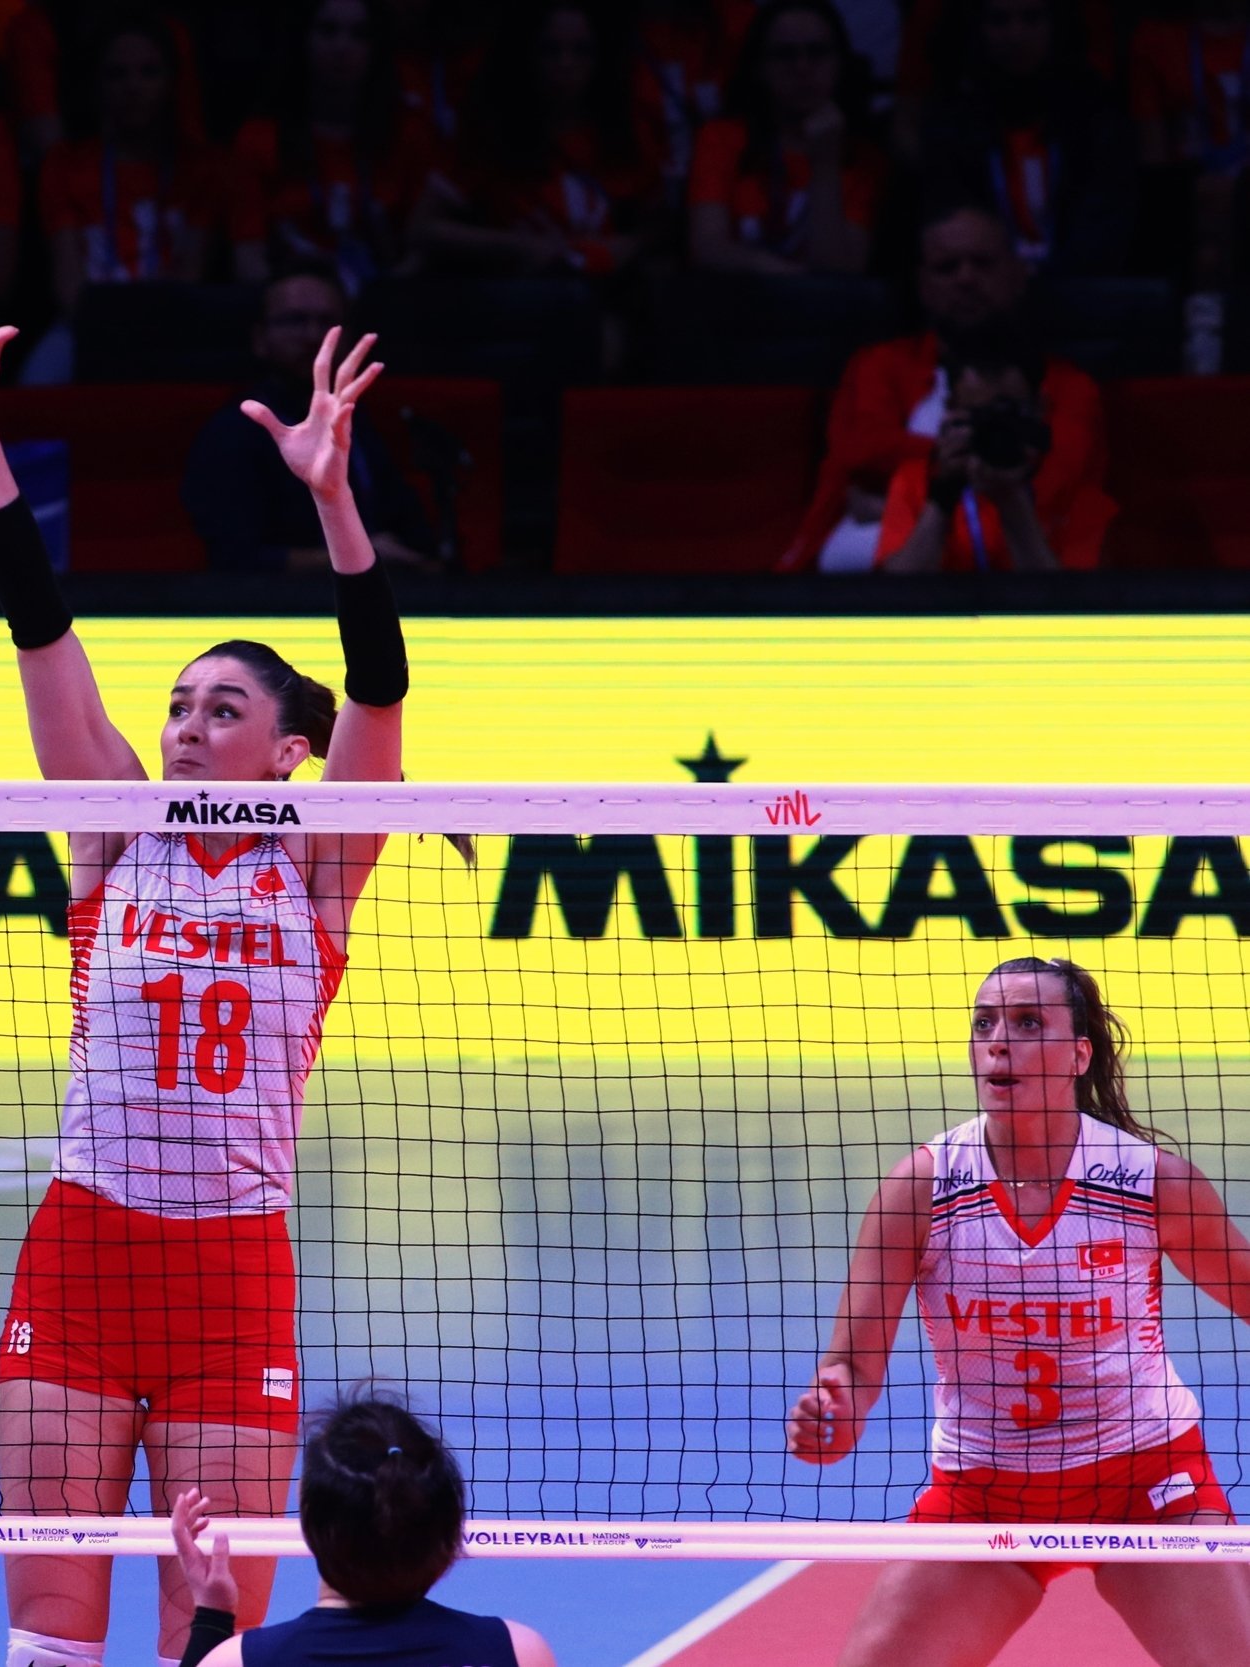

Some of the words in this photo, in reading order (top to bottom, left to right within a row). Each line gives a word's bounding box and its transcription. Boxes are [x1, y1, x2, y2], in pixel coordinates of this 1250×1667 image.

[165, 790, 301, 825] MIKASA
[765, 790, 822, 826] VNL
[121, 903, 297, 967] VESTEL
[141, 972, 251, 1095] 18
[1087, 1163, 1144, 1189] Orkid
[945, 1293, 1124, 1339] VESTEL
[7, 1319, 33, 1355] 18
[1010, 1350, 1062, 1429] 3
[462, 1532, 589, 1545] VOLLEYBALL
[592, 1532, 630, 1540] NATIONS
[1029, 1535, 1158, 1550] VOLLEYBALL
